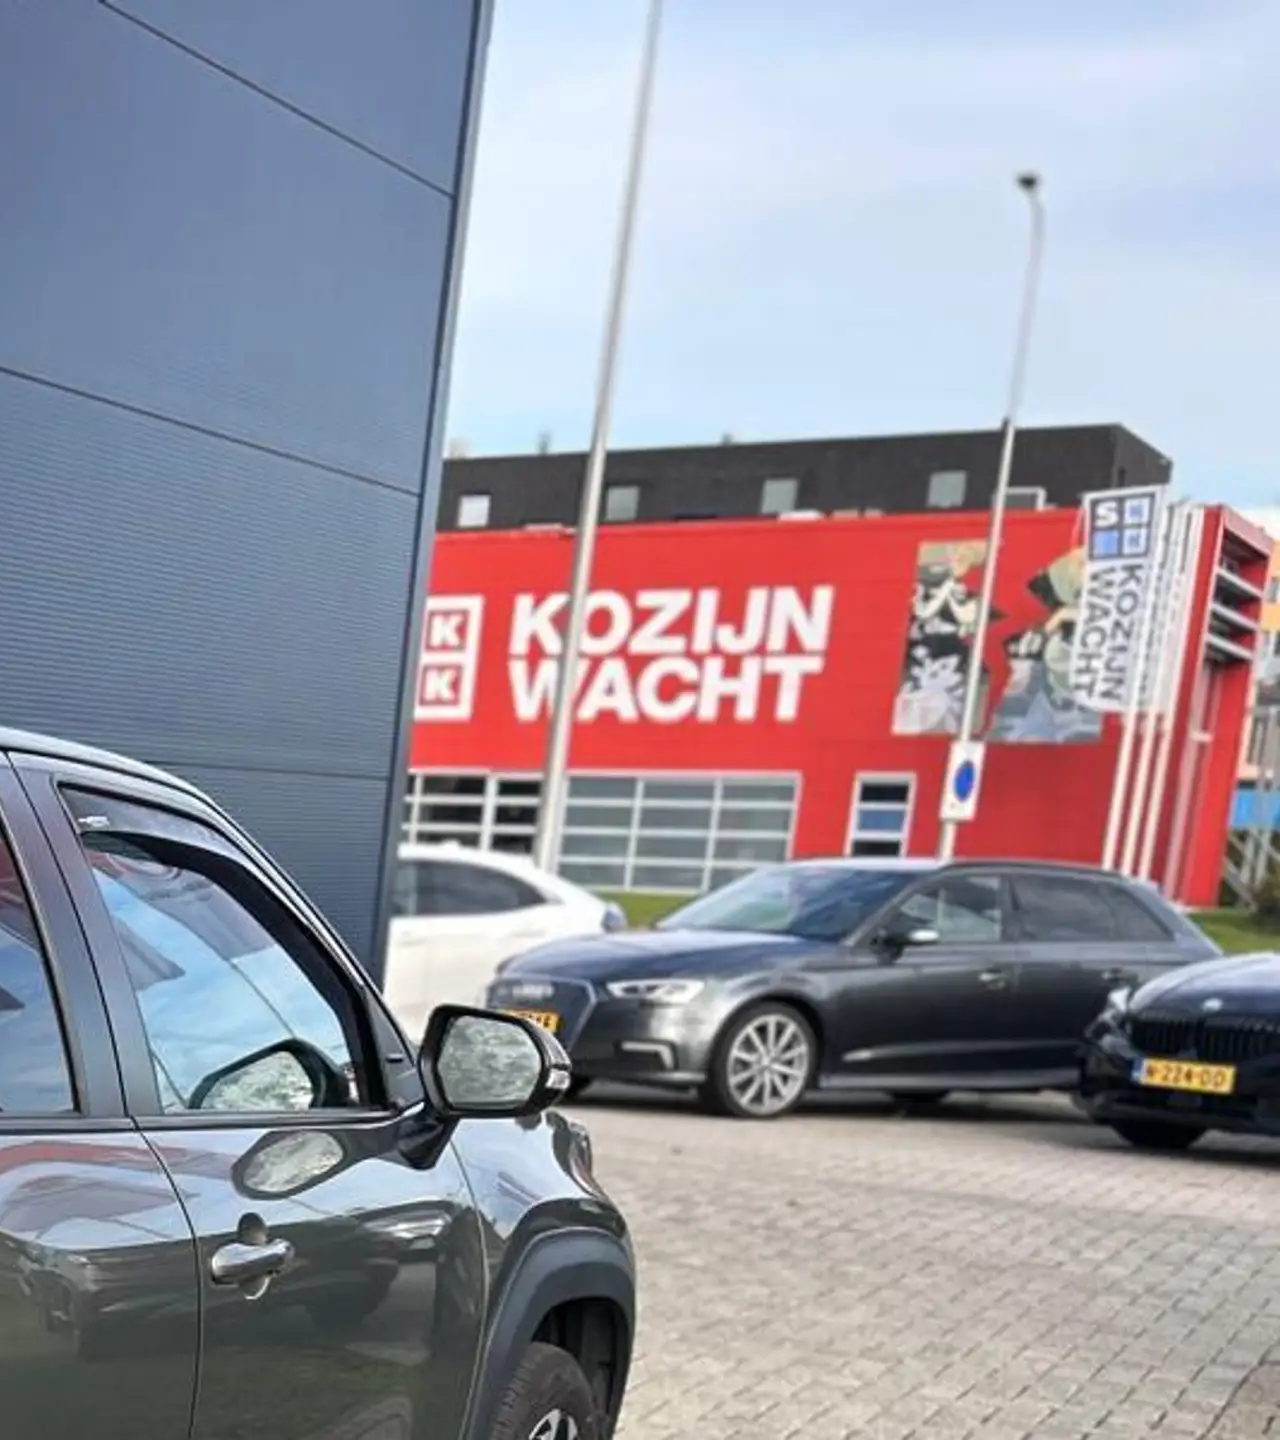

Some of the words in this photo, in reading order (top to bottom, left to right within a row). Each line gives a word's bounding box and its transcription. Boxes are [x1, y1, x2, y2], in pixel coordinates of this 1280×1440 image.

[508, 584, 835, 656] KOZIJN
[1074, 566, 1116, 700] WACHT
[1099, 564, 1144, 701] KOZIJN
[507, 655, 827, 723] WACHT
